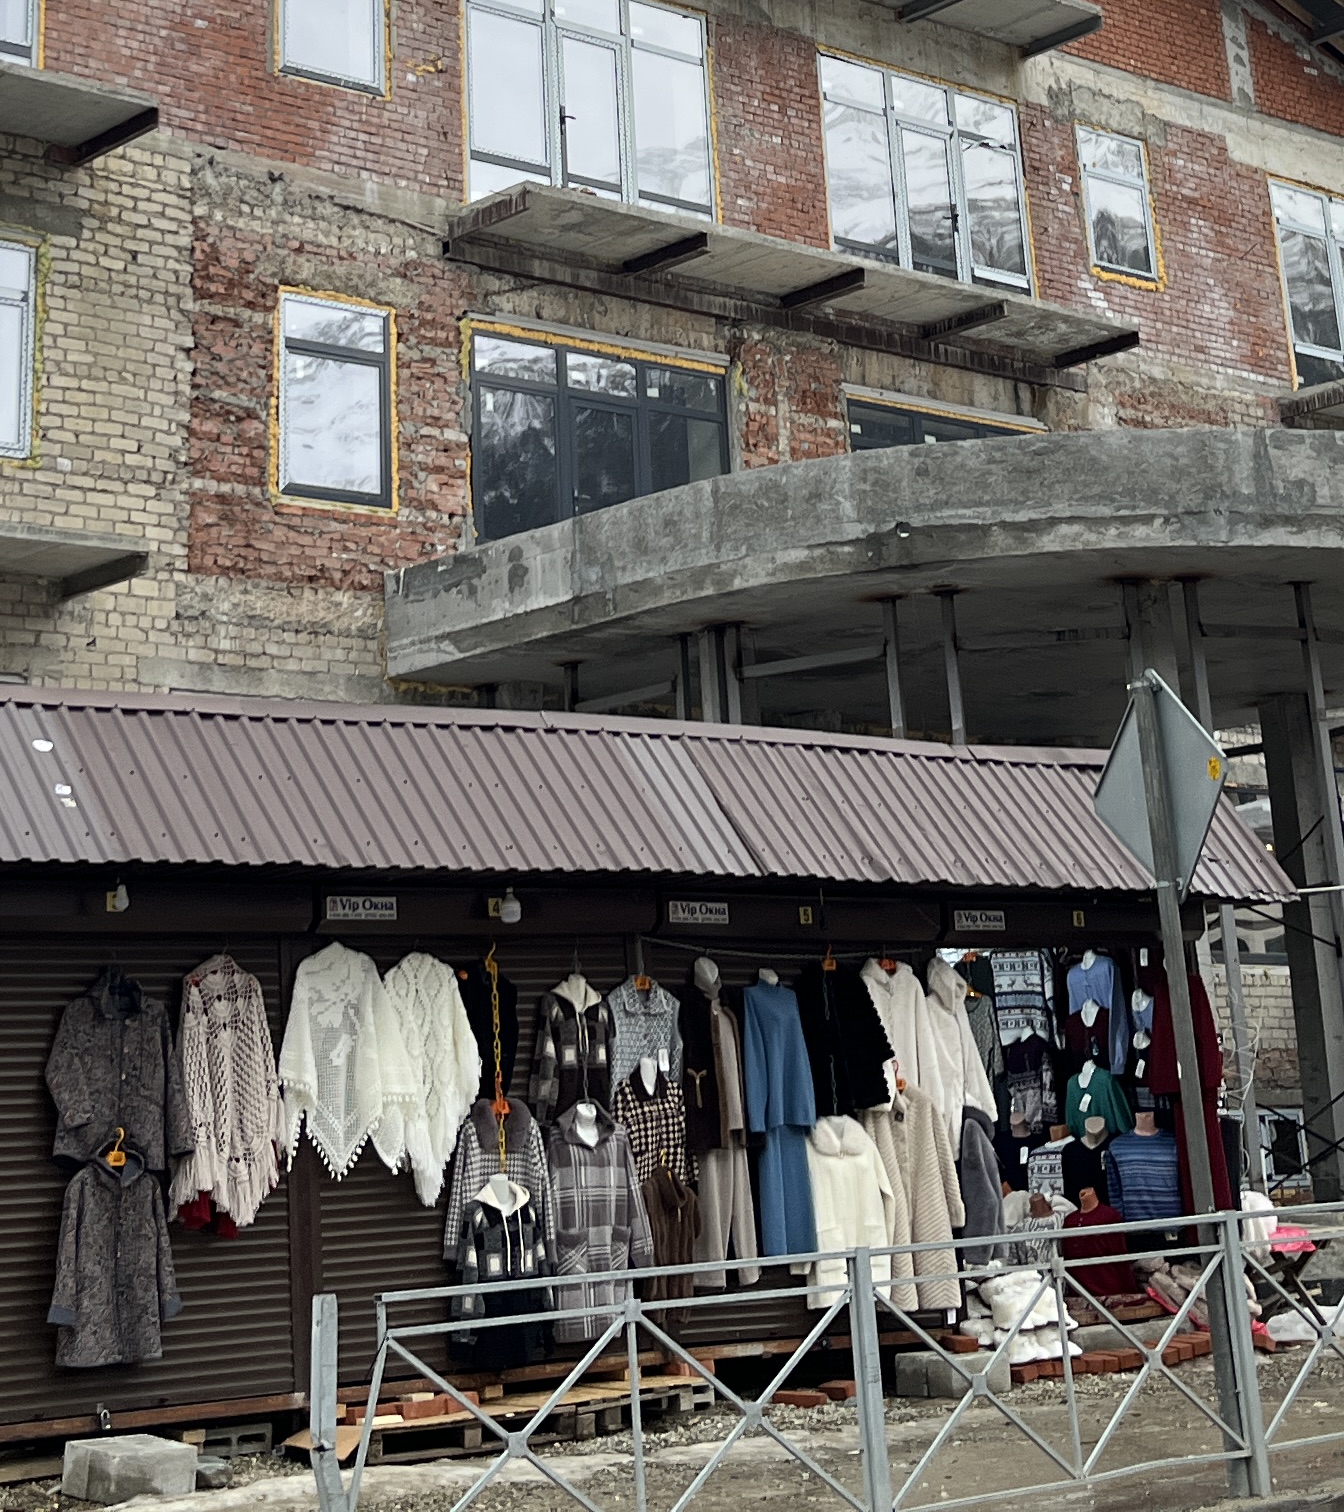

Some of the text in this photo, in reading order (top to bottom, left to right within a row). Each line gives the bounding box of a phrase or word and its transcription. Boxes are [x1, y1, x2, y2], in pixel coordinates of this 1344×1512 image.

[339, 898, 394, 911] Vip Окна
[492, 900, 500, 915] 4
[679, 903, 727, 916] Vip Окна
[803, 909, 810, 923] 5
[963, 911, 1003, 924] Vip Окна
